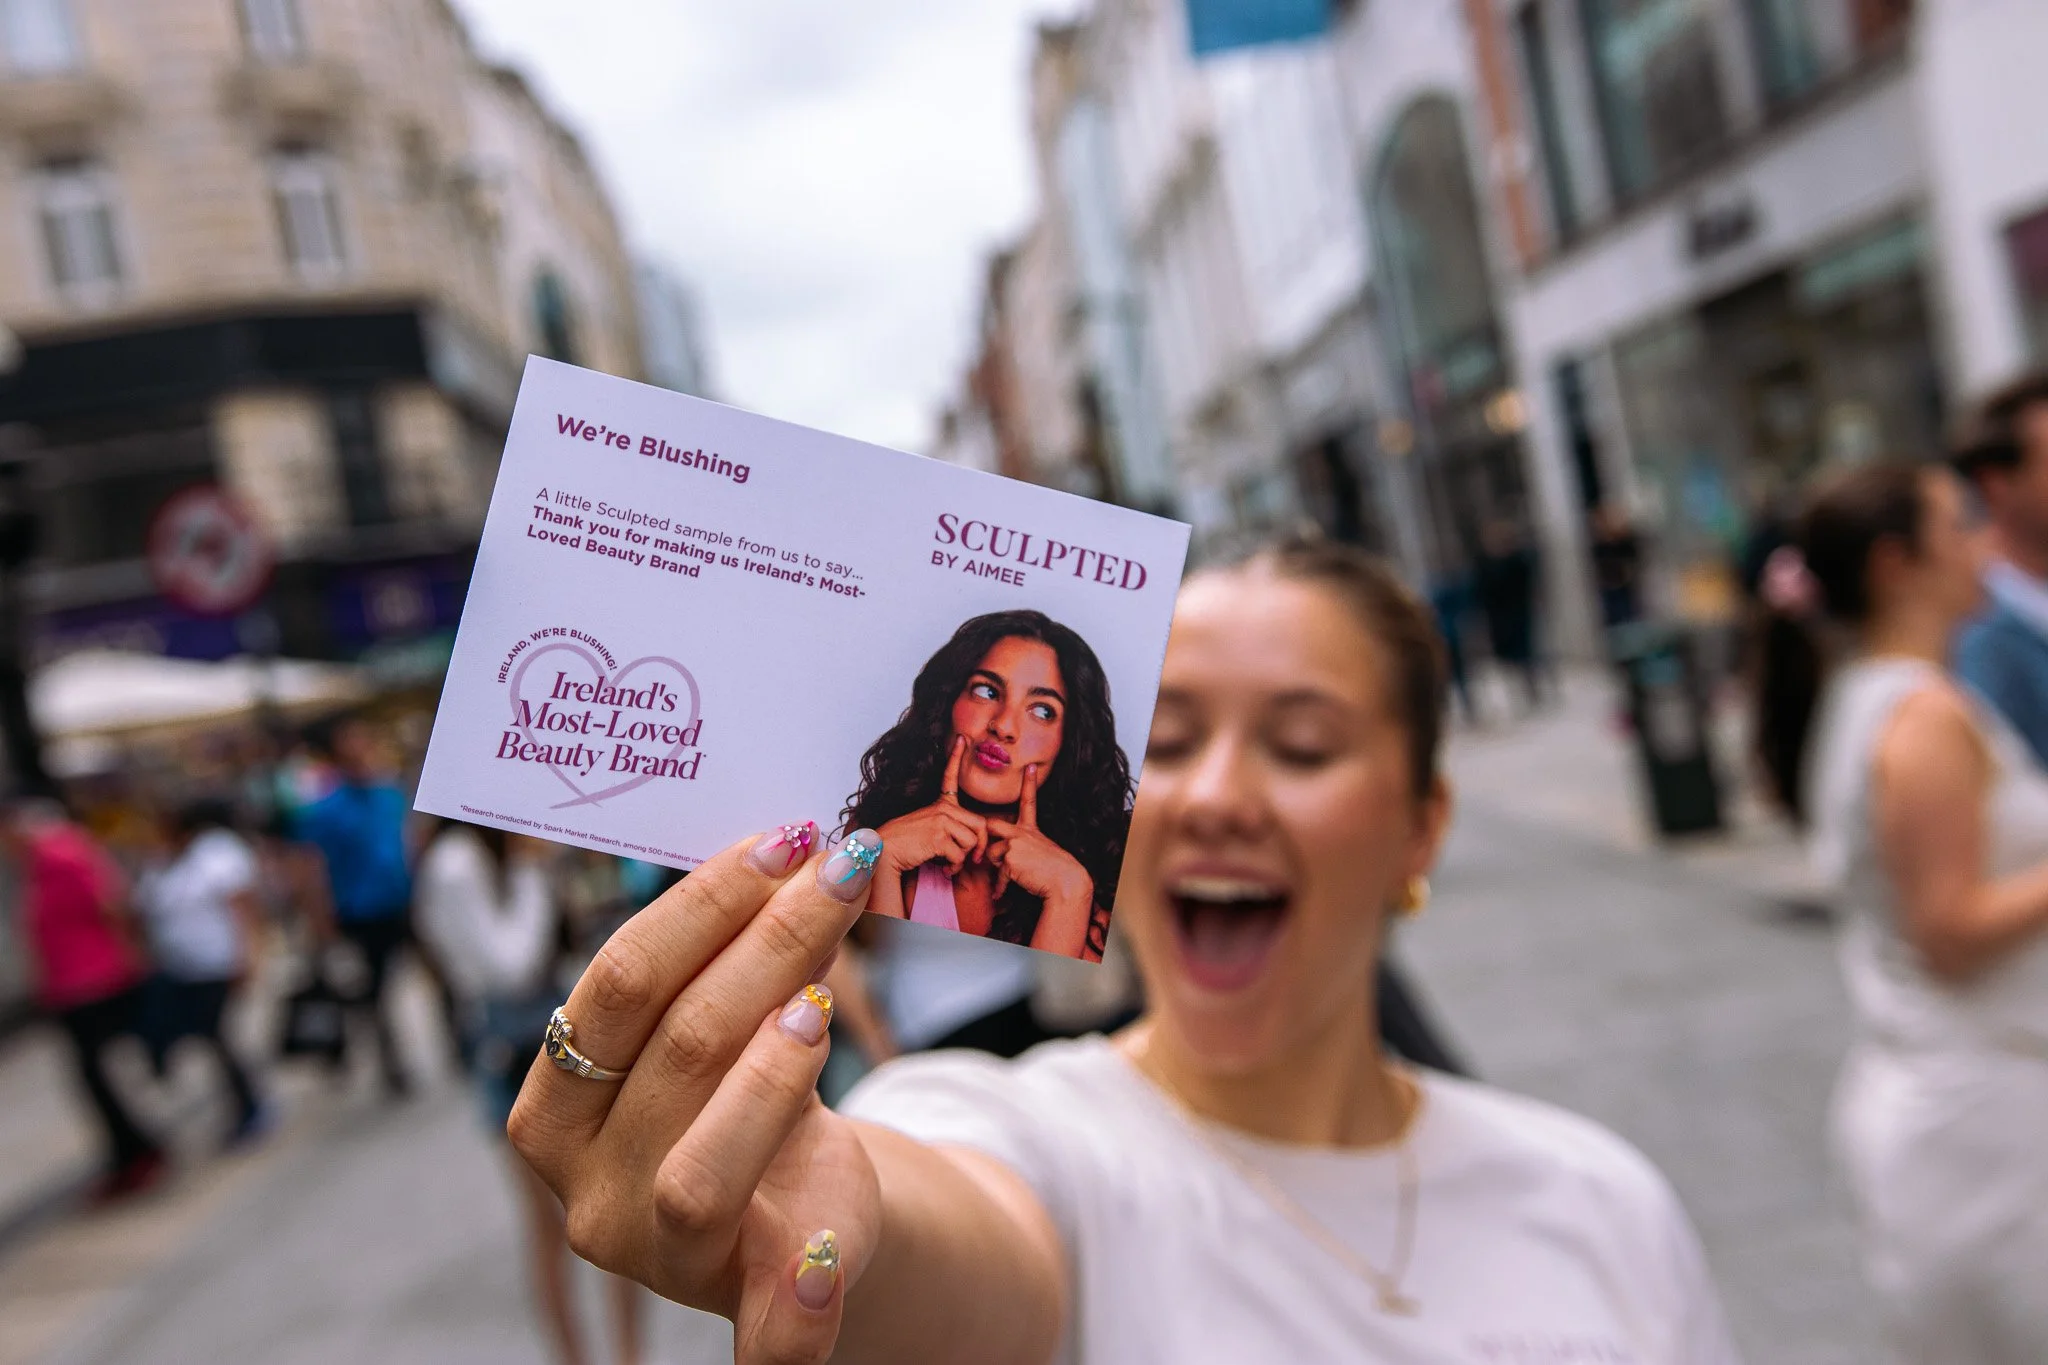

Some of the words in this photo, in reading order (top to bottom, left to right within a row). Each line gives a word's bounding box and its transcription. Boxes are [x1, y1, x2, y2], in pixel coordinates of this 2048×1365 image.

[557, 413, 631, 451] We’re
[638, 435, 751, 484] Blushing
[526, 523, 582, 550] Loved
[585, 538, 646, 567] Beauty
[649, 554, 701, 579] Brand
[533, 504, 584, 530] Thank
[587, 521, 621, 539] you
[624, 528, 651, 546] for
[653, 537, 716, 565] making
[720, 554, 740, 569] us
[743, 557, 815, 587] Ireland’s
[818, 576, 866, 598] Most-
[536, 487, 549, 502] A
[554, 490, 592, 512] little
[596, 501, 671, 532] Sculpted
[674, 523, 733, 547] sample
[737, 536, 777, 558] from
[780, 550, 799, 564] us
[804, 553, 821, 569] to
[825, 561, 864, 581] say...
[934, 512, 1148, 591] SCULPTED
[930, 549, 959, 569] BY
[962, 559, 1026, 587] AIMEE
[497, 639, 531, 684] IRELAND,
[529, 627, 568, 642] WE’RE
[569, 628, 618, 671] BLUSHING!
[549, 671, 678, 713] Ireland's
[509, 699, 704, 747] Most-Loved
[495, 730, 606, 777] Beauty
[495, 812, 532, 828] conducted
[533, 820, 542, 830] by
[543, 823, 563, 835] Spark
[564, 828, 588, 840] Market
[589, 833, 622, 848] Research,
[623, 842, 647, 853] among
[648, 847, 663, 856] 500
[663, 851, 691, 863] makeup
